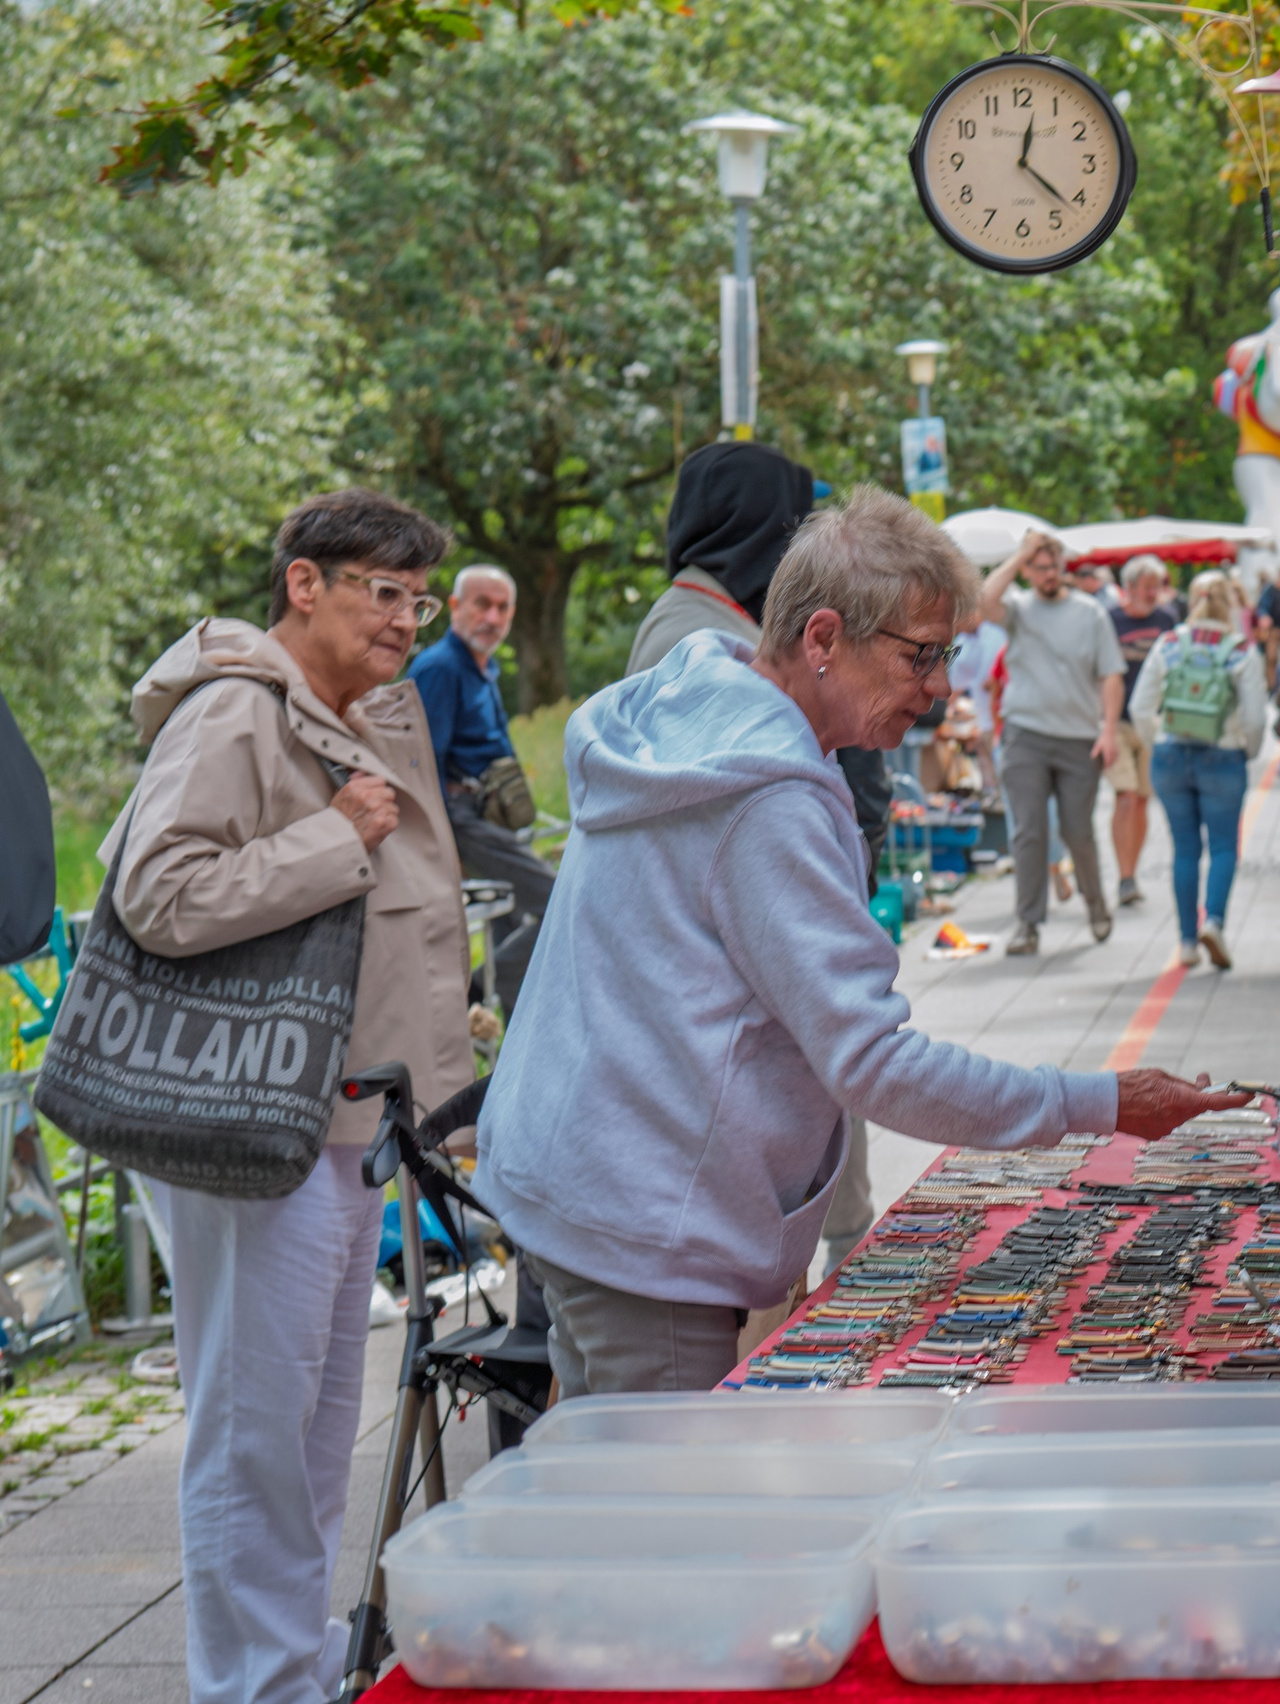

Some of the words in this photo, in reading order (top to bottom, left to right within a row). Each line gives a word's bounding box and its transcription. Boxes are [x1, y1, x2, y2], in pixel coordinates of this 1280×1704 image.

[985, 95, 999, 117] 11
[1012, 87, 1033, 108] 12
[1051, 96, 1059, 117] 1
[957, 119, 977, 140] 10
[1071, 120, 1087, 142] 2
[950, 151, 965, 173] 9
[1081, 153, 1097, 174] 3
[959, 184, 974, 205] 8
[1072, 187, 1087, 208] 4
[983, 208, 998, 229] 7
[1015, 217, 1031, 238] 6
[1048, 209, 1063, 231] 5
[140, 955, 260, 1002] HOLLAND
[59, 970, 309, 1087] HOLLAND
[103, 1085, 175, 1113] HOLLAND
[177, 1099, 251, 1121] HOLLAND
[255, 1104, 321, 1136] HOLLAND
